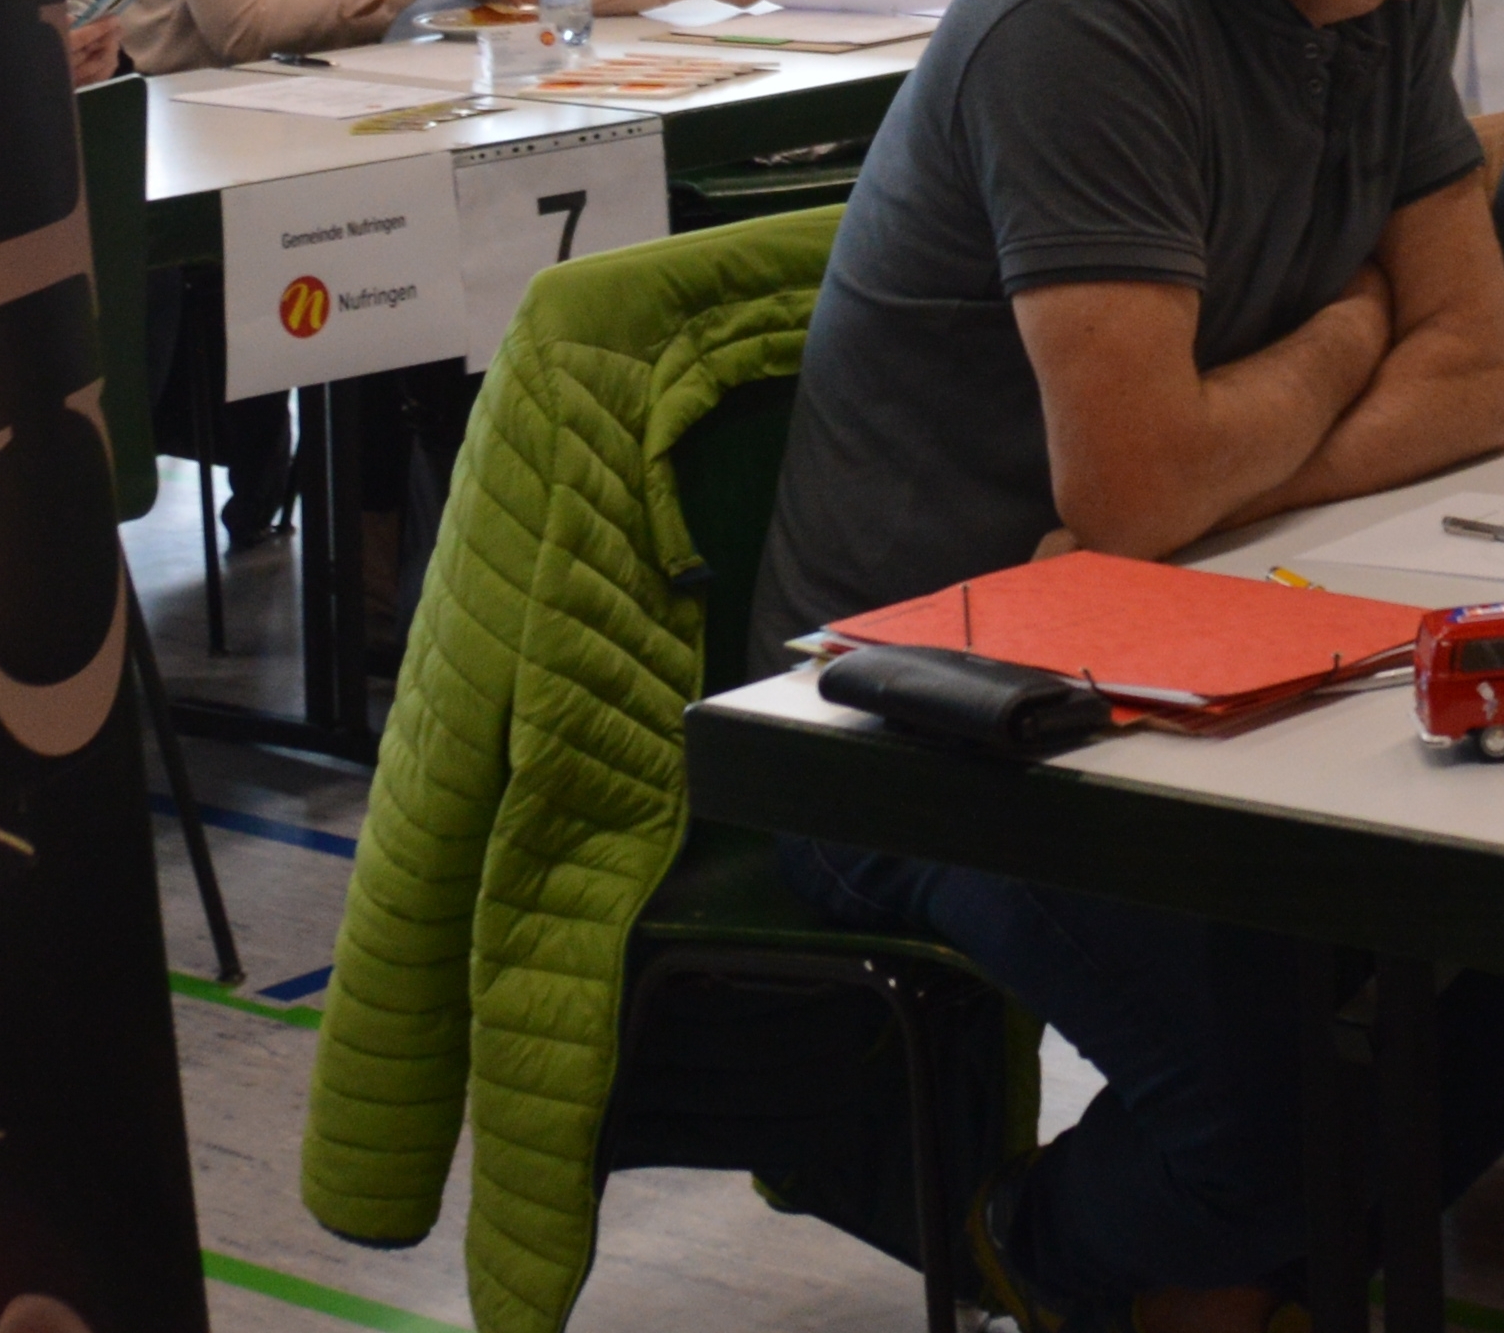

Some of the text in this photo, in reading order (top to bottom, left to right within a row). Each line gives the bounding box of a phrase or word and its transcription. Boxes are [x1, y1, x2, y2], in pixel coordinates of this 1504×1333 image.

[280, 212, 406, 251] Gemeinde Nufringen
[536, 189, 587, 263] 7
[337, 281, 417, 314] Nufringen
